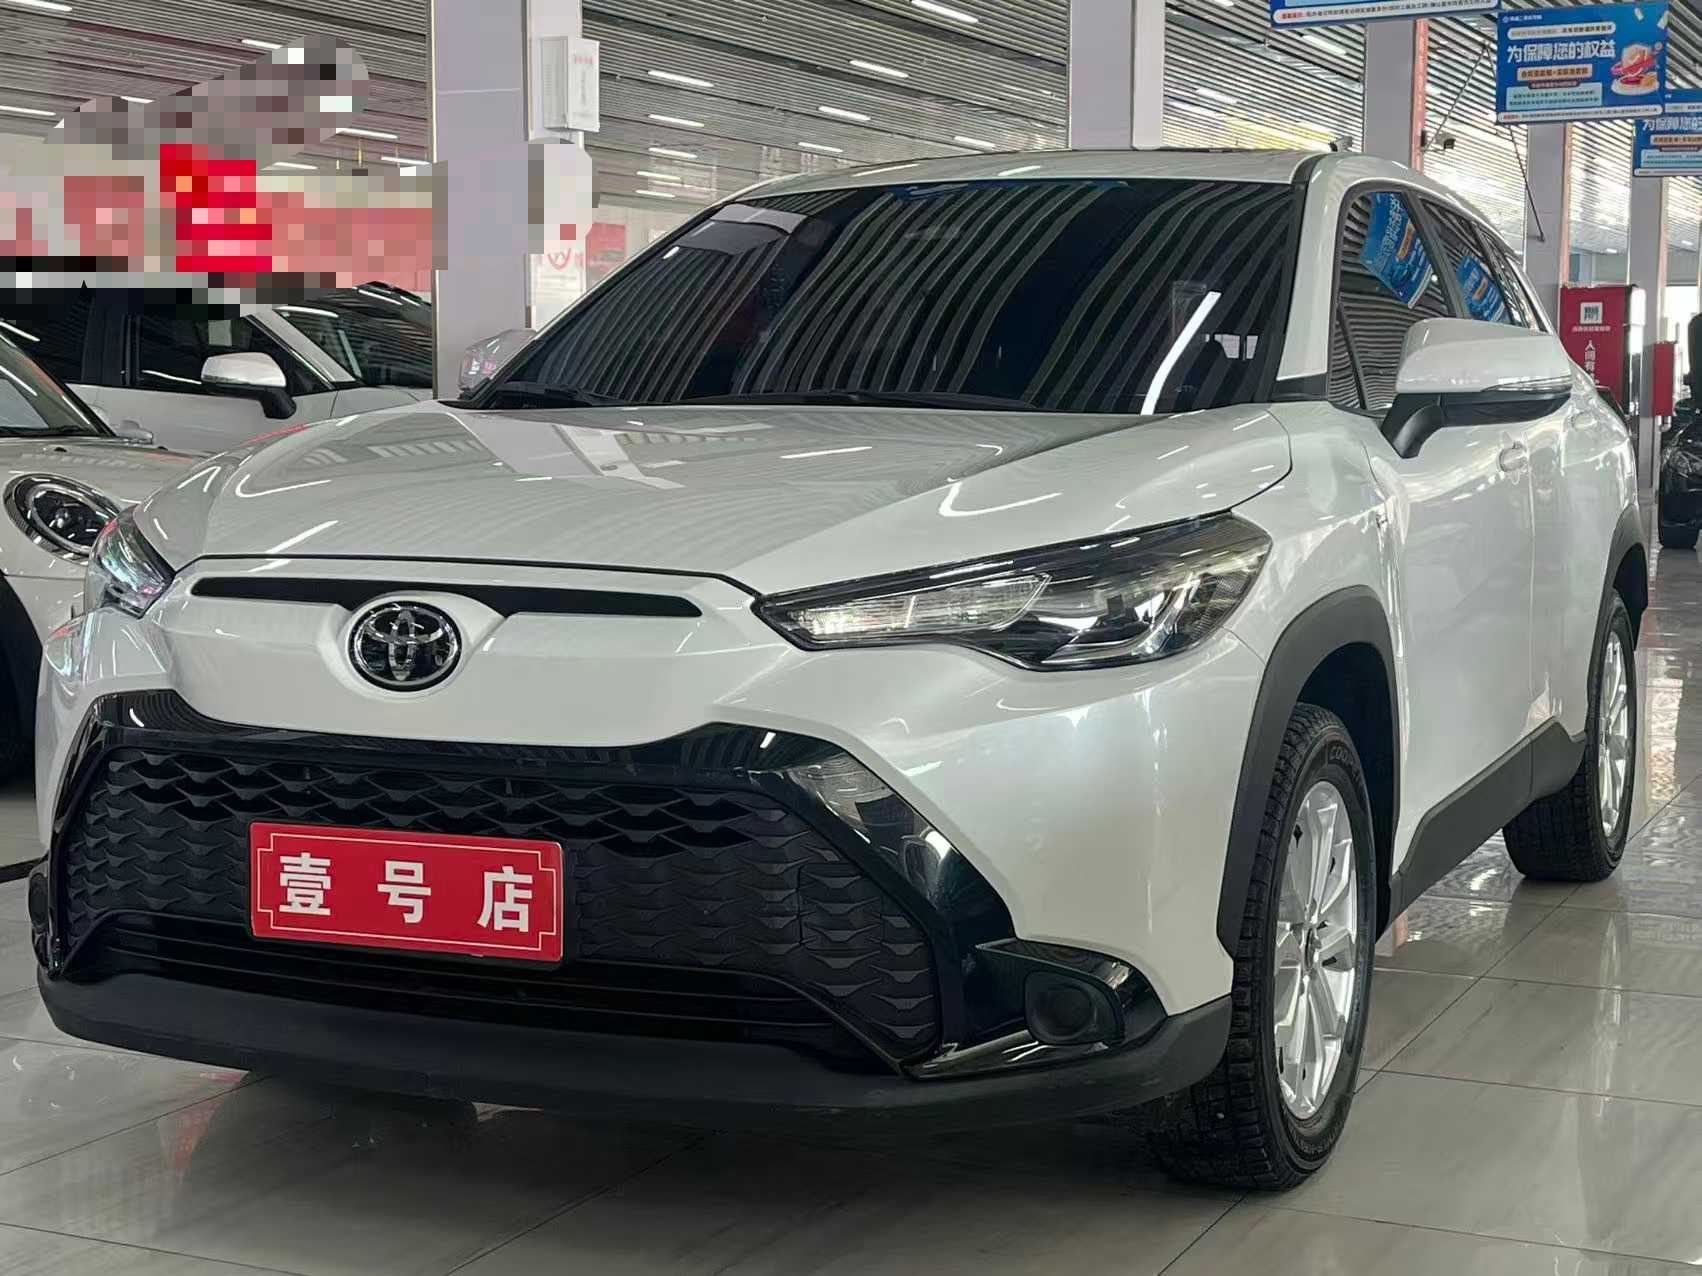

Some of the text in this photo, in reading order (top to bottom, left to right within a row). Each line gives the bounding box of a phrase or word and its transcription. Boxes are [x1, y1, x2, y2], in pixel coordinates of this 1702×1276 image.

[1507, 40, 1616, 63] 为保障您的权益
[279, 852, 533, 933] 壹号店
